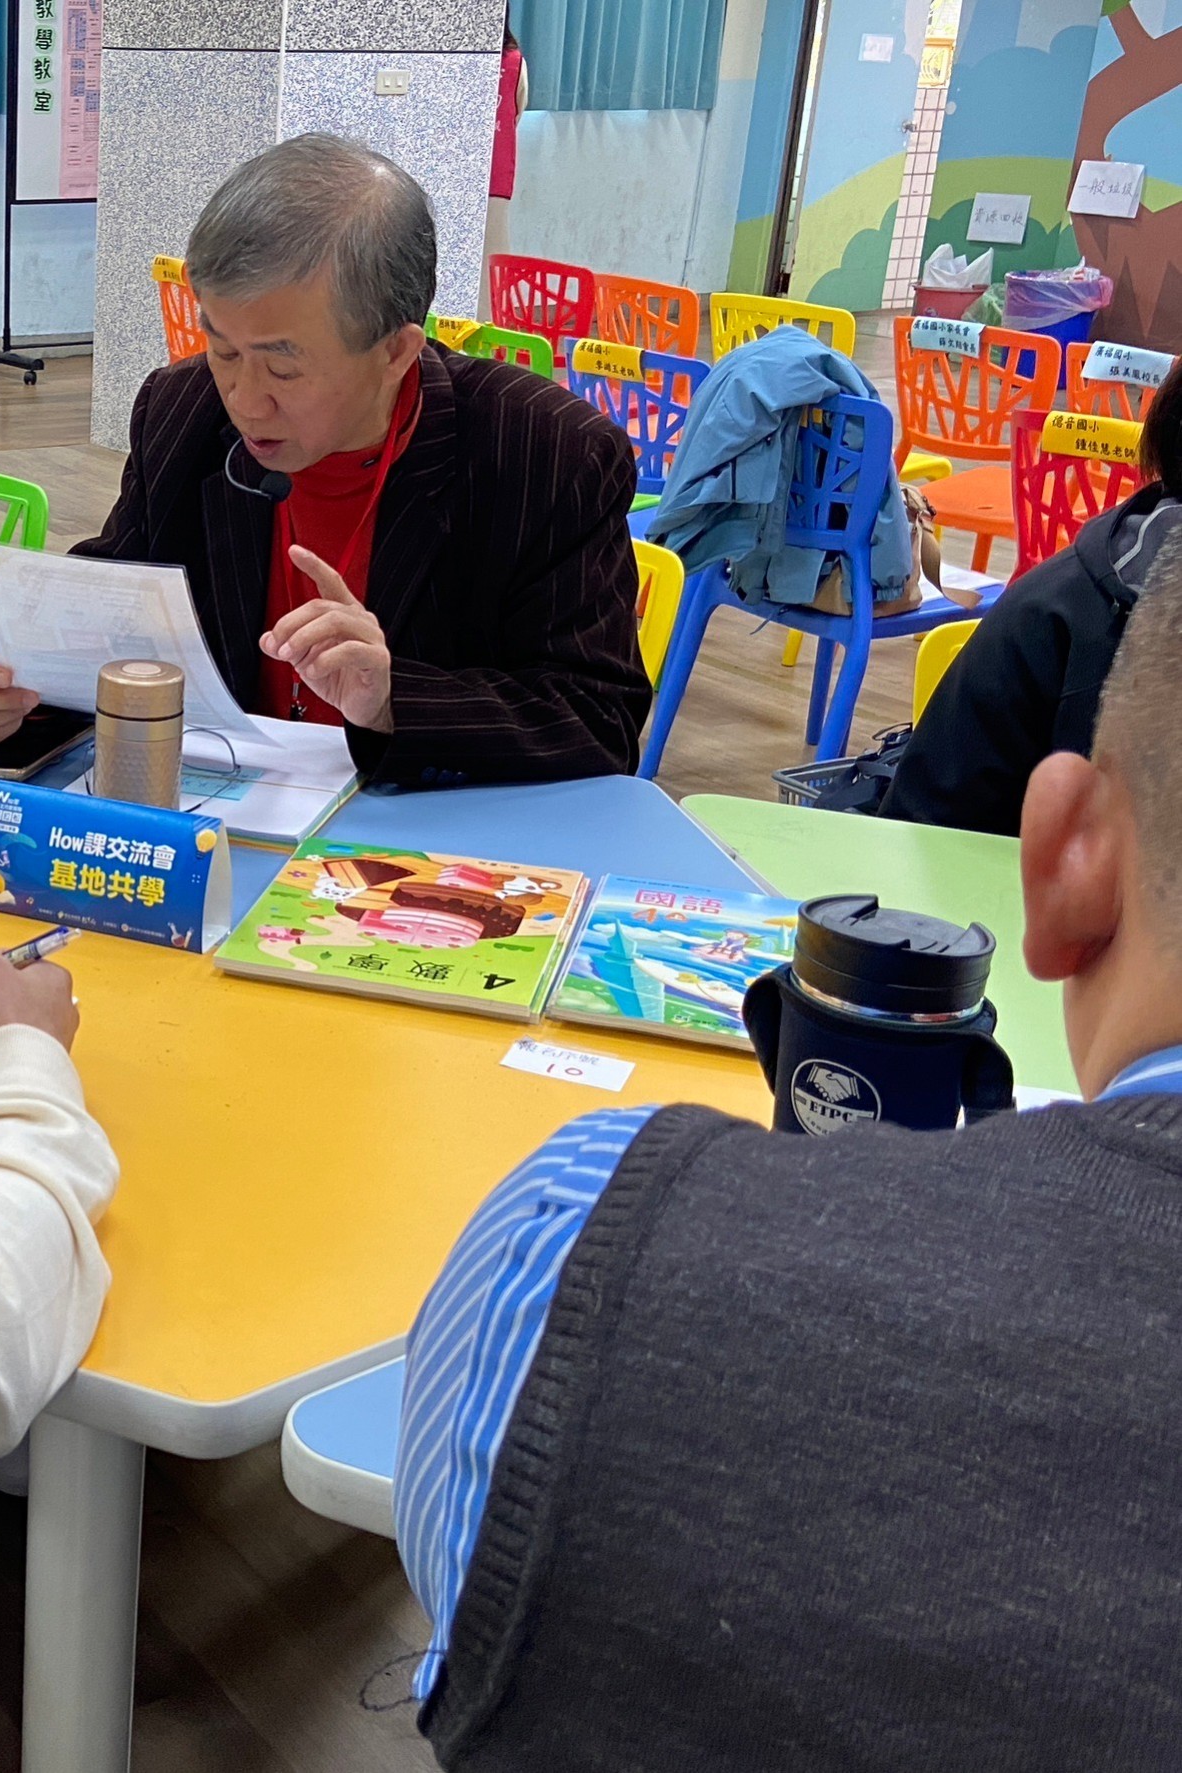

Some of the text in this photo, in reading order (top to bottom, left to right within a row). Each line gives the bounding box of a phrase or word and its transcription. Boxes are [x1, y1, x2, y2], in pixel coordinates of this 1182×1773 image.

[34, 0, 54, 111] 教學教室
[1078, 177, 1134, 197] 一般垃圾
[974, 207, 1025, 227] 資源回收
[1052, 414, 1100, 433] 德音國小
[48, 826, 177, 871] How課交流會
[49, 858, 166, 907] 基地共學
[635, 889, 722, 915] 國語
[483, 973, 516, 990] 4
[809, 1100, 854, 1123] ETPC
